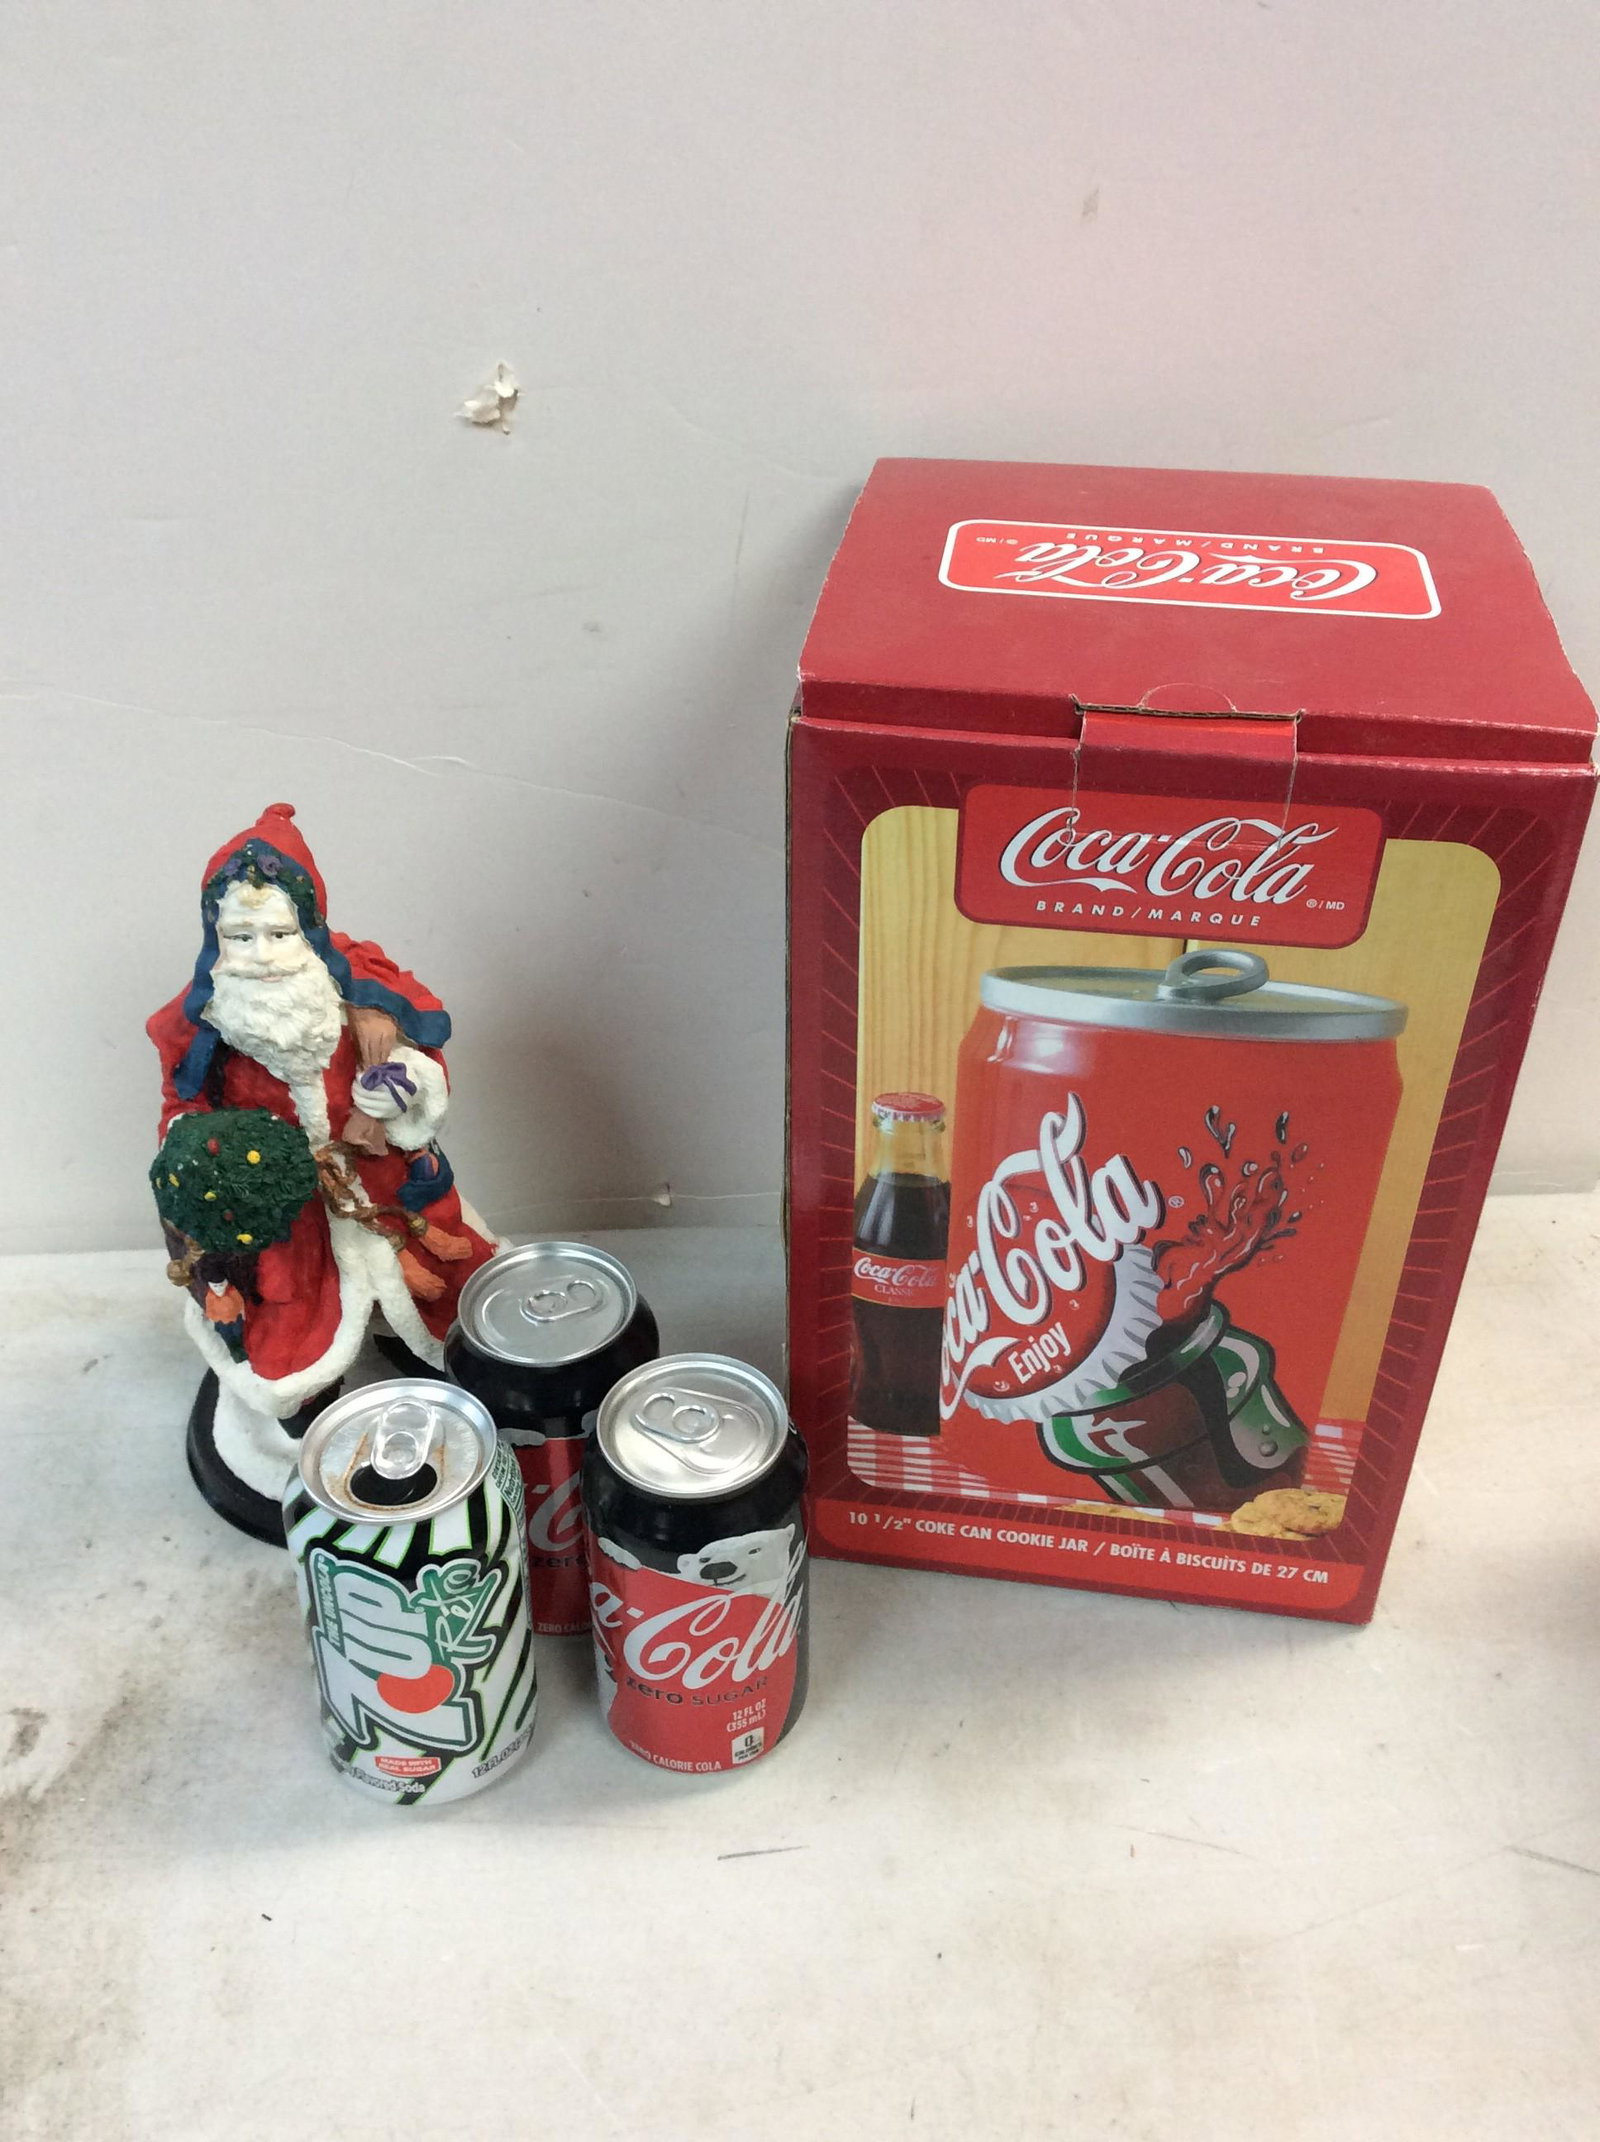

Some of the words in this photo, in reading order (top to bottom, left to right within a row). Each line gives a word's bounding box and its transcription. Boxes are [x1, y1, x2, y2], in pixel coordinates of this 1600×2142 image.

[994, 541, 1377, 601] Coca-Cola
[1000, 806, 1339, 904] Coca-Cola
[854, 1257, 938, 1287] Coca-Cola
[1008, 1322, 1072, 1384] Enjoy
[849, 1511, 868, 1525] 10
[915, 1519, 955, 1536] COKE
[960, 1524, 992, 1540] CAN
[996, 1529, 1055, 1548] COOKIE
[1058, 1537, 1089, 1552] JAR
[1251, 1562, 1272, 1576] DE
[1276, 1565, 1298, 1579] 27
[1303, 1568, 1329, 1584] CM
[317, 1562, 339, 1620] UNCOLA
[326, 1619, 343, 1646] THE
[626, 1677, 683, 1705] zero
[692, 1676, 768, 1706] SUGAR
[733, 1710, 745, 1721] 12
[744, 1705, 755, 1718] FL
[755, 1698, 767, 1714] OZ
[652, 1754, 694, 1772] CALORIE
[696, 1761, 722, 1773] COLA
[398, 1781, 426, 1793] Soda
